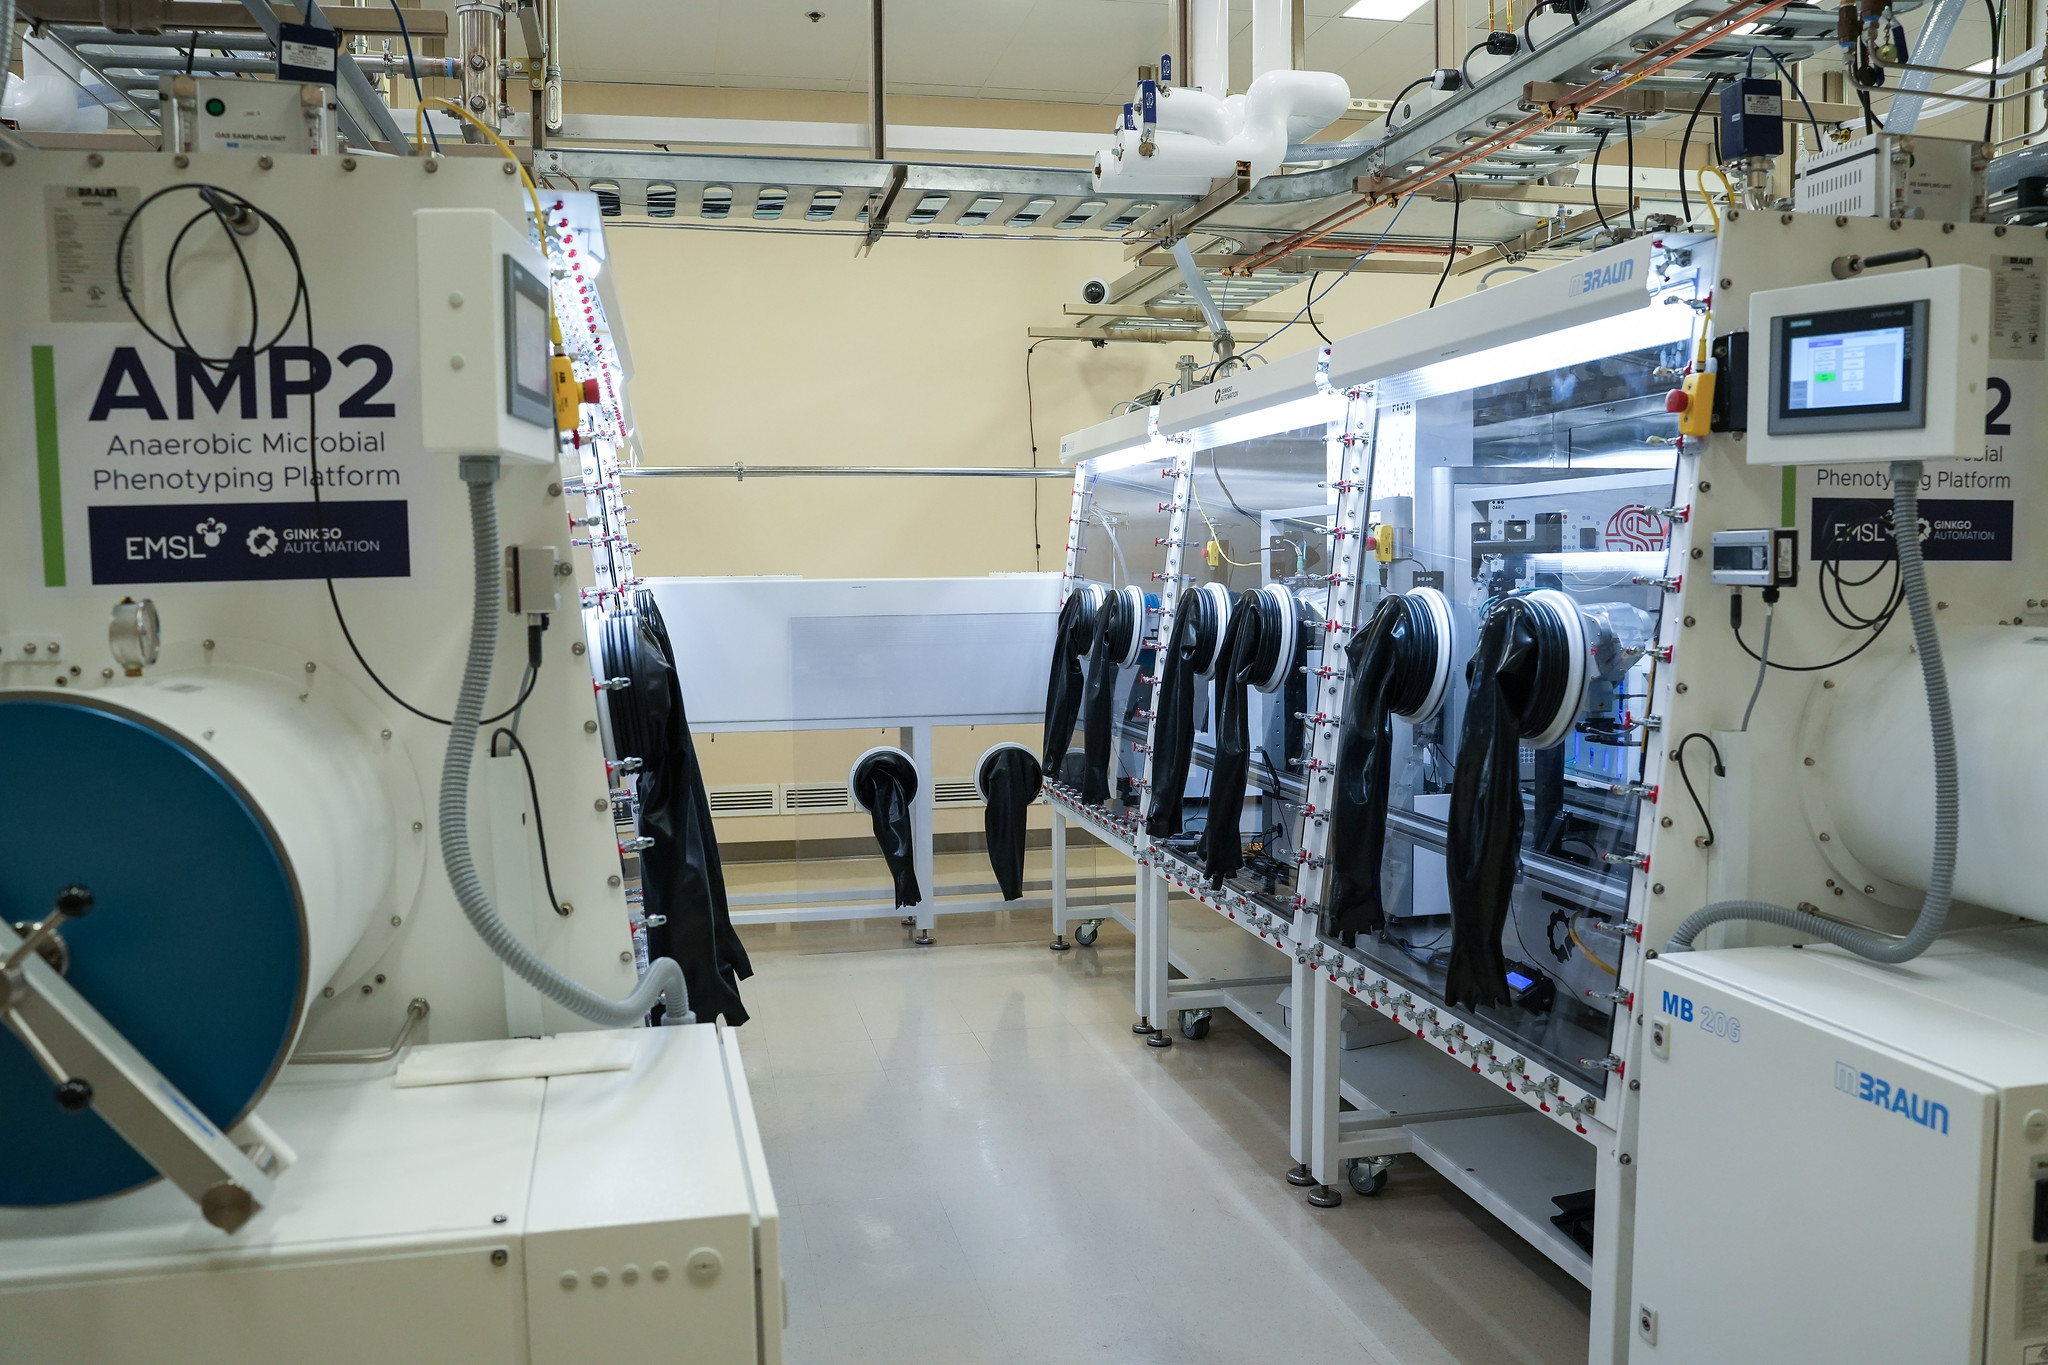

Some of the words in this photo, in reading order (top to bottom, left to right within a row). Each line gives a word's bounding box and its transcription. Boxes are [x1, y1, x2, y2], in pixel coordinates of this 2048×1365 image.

[88, 344, 396, 421] AMP2
[107, 432, 252, 456] Anaerobic
[263, 431, 385, 454] Micobial
[93, 467, 274, 494] Phenotyping
[284, 464, 401, 488] Platform
[1817, 469, 1931, 491] Phenotyg
[1937, 471, 2011, 489] Platform
[1934, 520, 1972, 530] GINKGO
[1934, 530, 1995, 541] AUTOMATION
[126, 535, 207, 561] EMSL
[1662, 990, 1694, 1023] MB
[1700, 1005, 1741, 1043] 20G
